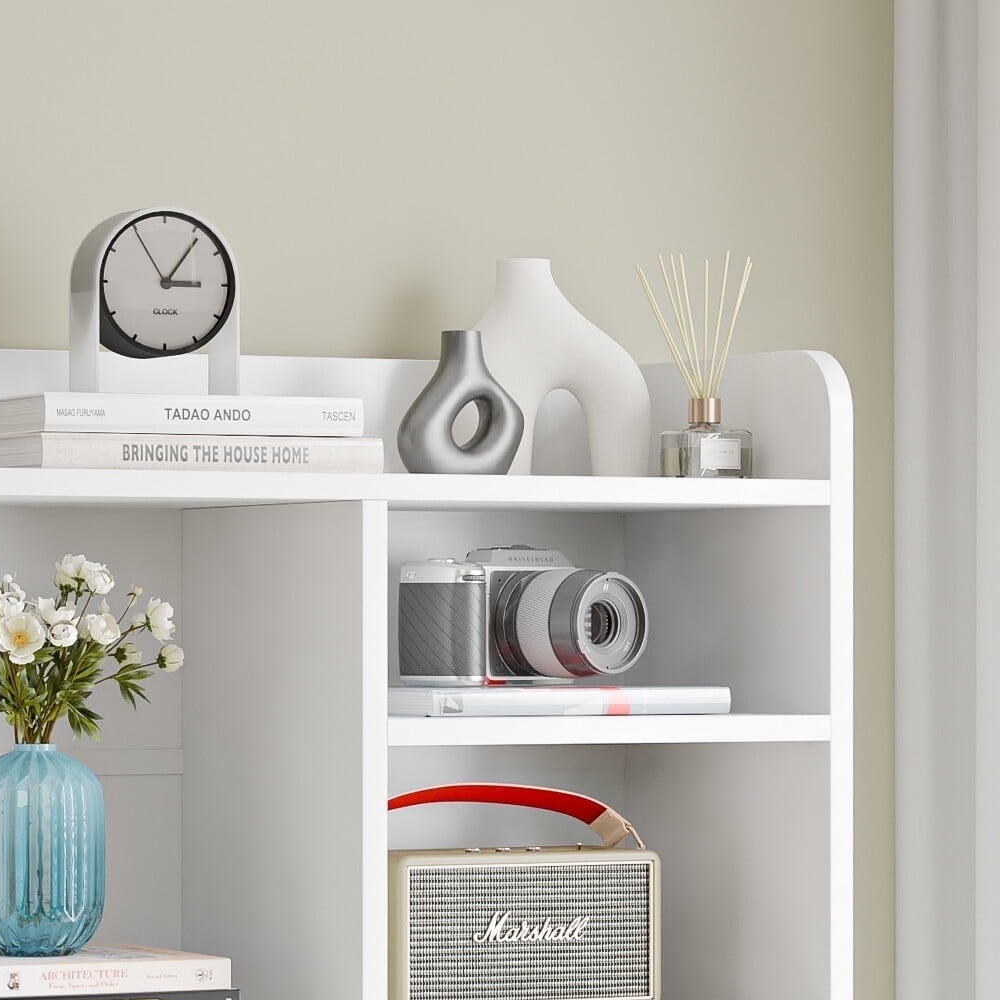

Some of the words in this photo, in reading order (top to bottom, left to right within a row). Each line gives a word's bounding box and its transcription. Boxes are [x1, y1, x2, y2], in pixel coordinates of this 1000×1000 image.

[153, 308, 178, 316] CLOCK
[56, 408, 75, 417] MASAO
[76, 408, 105, 417] FURUYAMA
[164, 407, 210, 422] TADAO
[213, 408, 251, 422] ANDO
[321, 411, 356, 422] TASCEN
[122, 443, 189, 463] BRINGING
[193, 444, 219, 464] THE
[223, 445, 268, 464] HOUSE
[271, 446, 310, 465] HOME
[473, 910, 590, 943] Marshall
[40, 968, 128, 981] ARCHITECTURE
